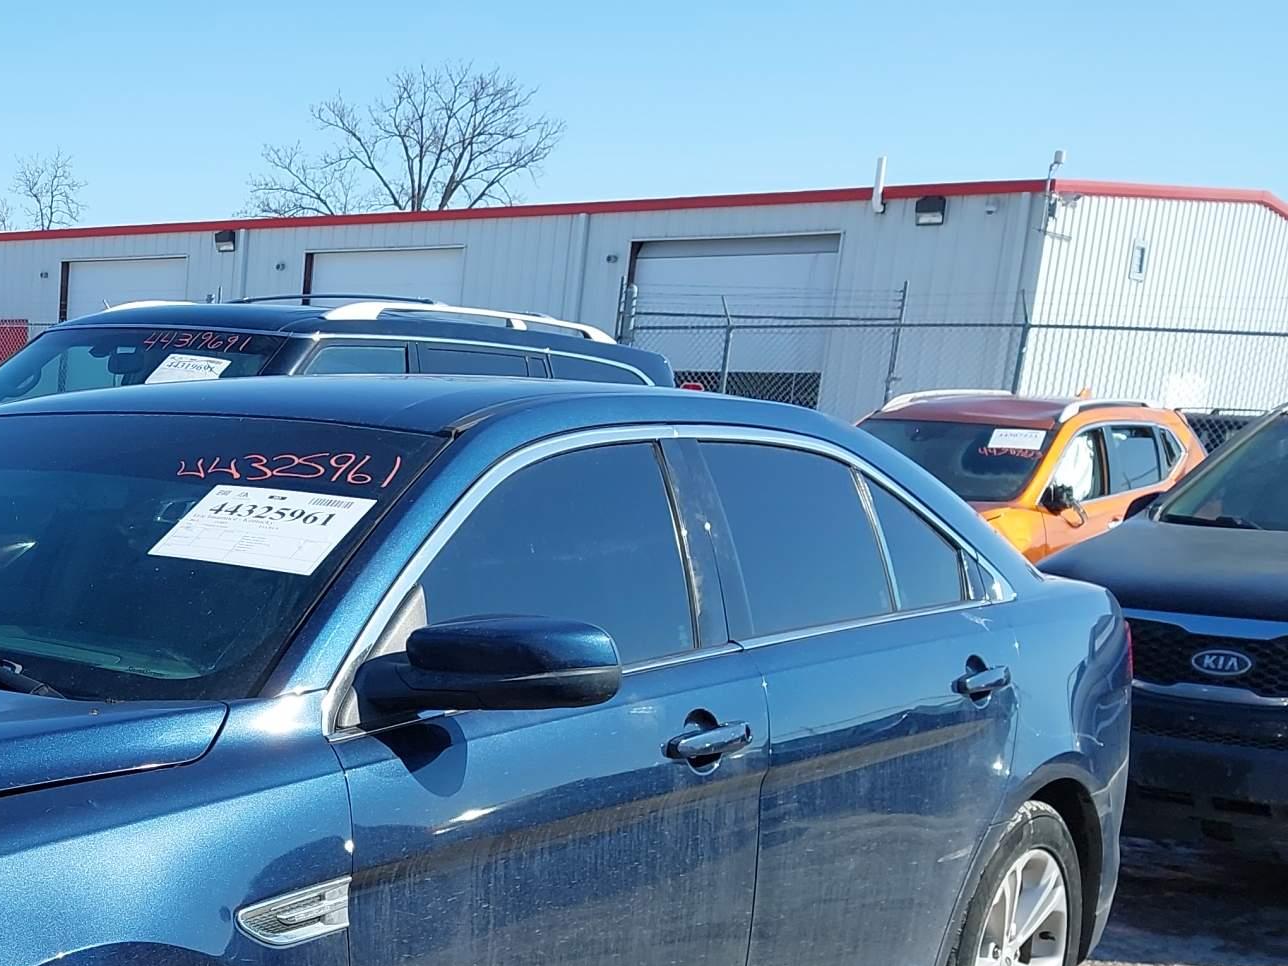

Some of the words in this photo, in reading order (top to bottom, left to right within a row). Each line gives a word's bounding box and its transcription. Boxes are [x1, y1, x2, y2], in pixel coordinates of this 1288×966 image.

[144, 331, 252, 353] 44319691
[176, 453, 401, 488] 44325961
[209, 502, 336, 526] 44325961
[1203, 655, 1239, 670] KIA
